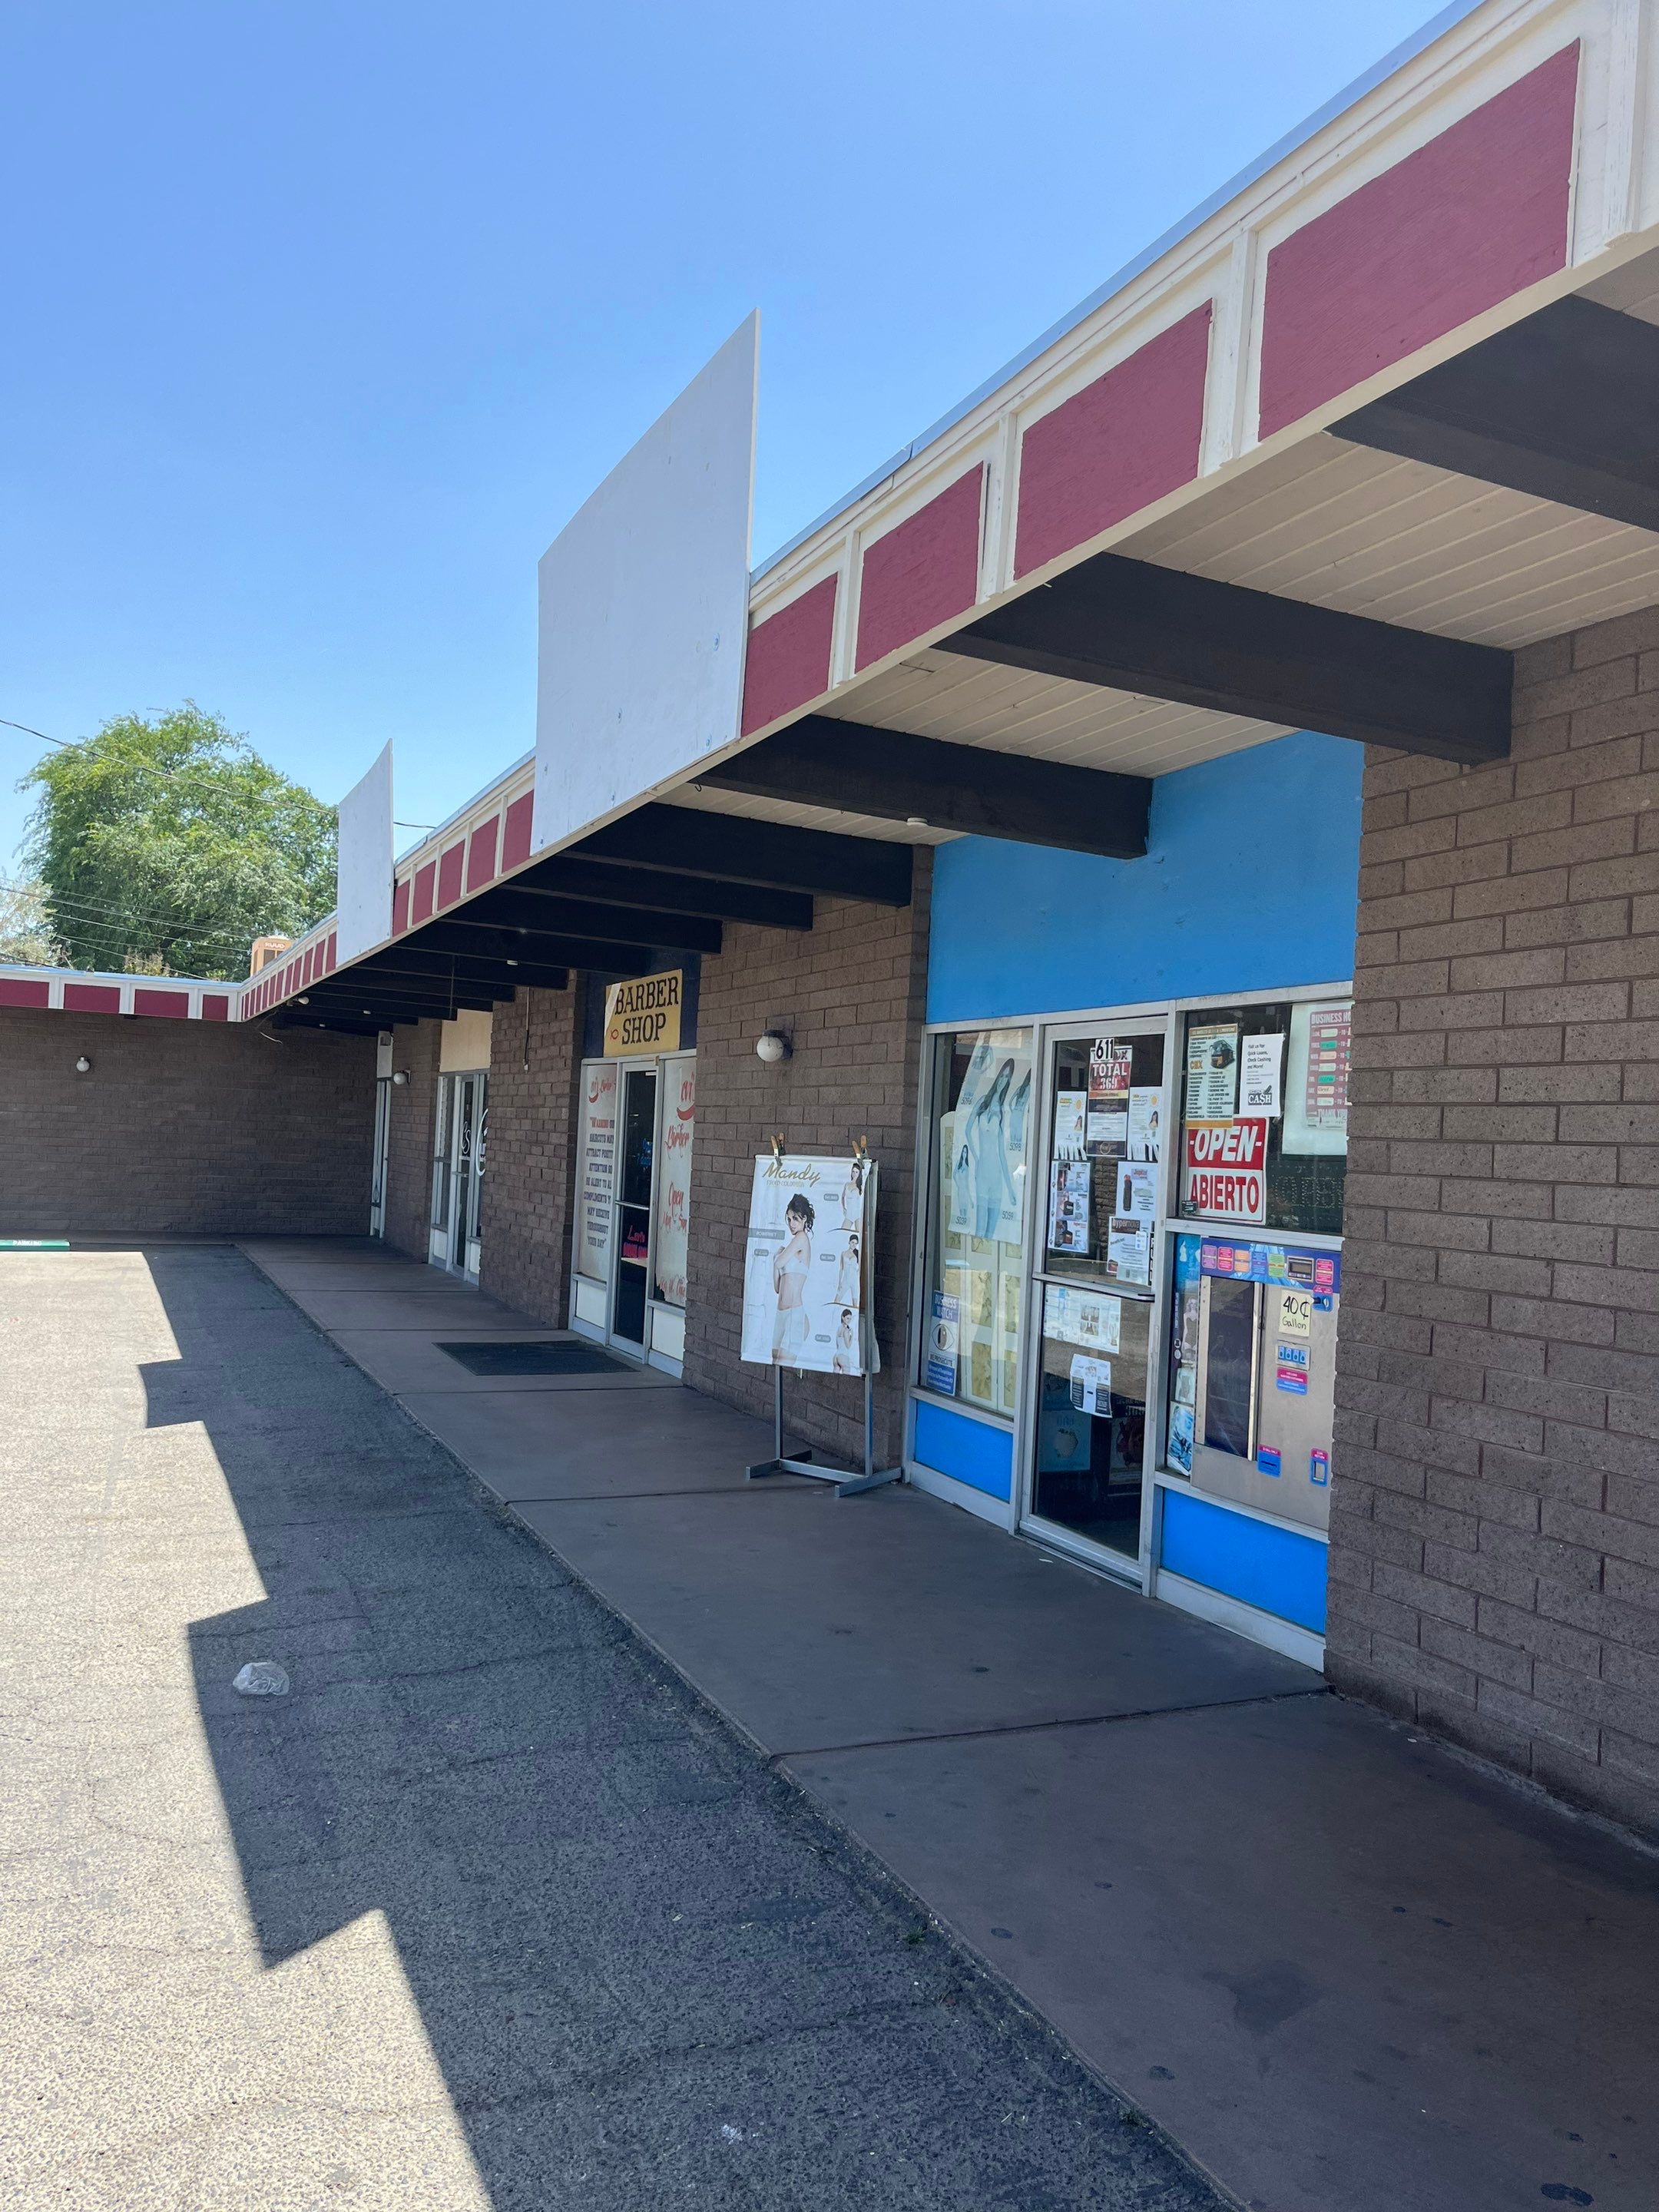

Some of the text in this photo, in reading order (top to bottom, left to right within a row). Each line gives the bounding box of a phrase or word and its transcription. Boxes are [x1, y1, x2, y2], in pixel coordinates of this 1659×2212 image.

[614, 975, 679, 1015] BARBER
[621, 1012, 667, 1045] SHOP
[1311, 1012, 1343, 1025] BUSINESS
[1096, 1039, 1114, 1059] 611
[1092, 1063, 1128, 1077] TOTAL
[1194, 1126, 1259, 1162] OPEN
[762, 1161, 821, 1187] Mandy
[1190, 1174, 1260, 1214] ABIERTO
[1283, 1316, 1306, 1330] Gallon
